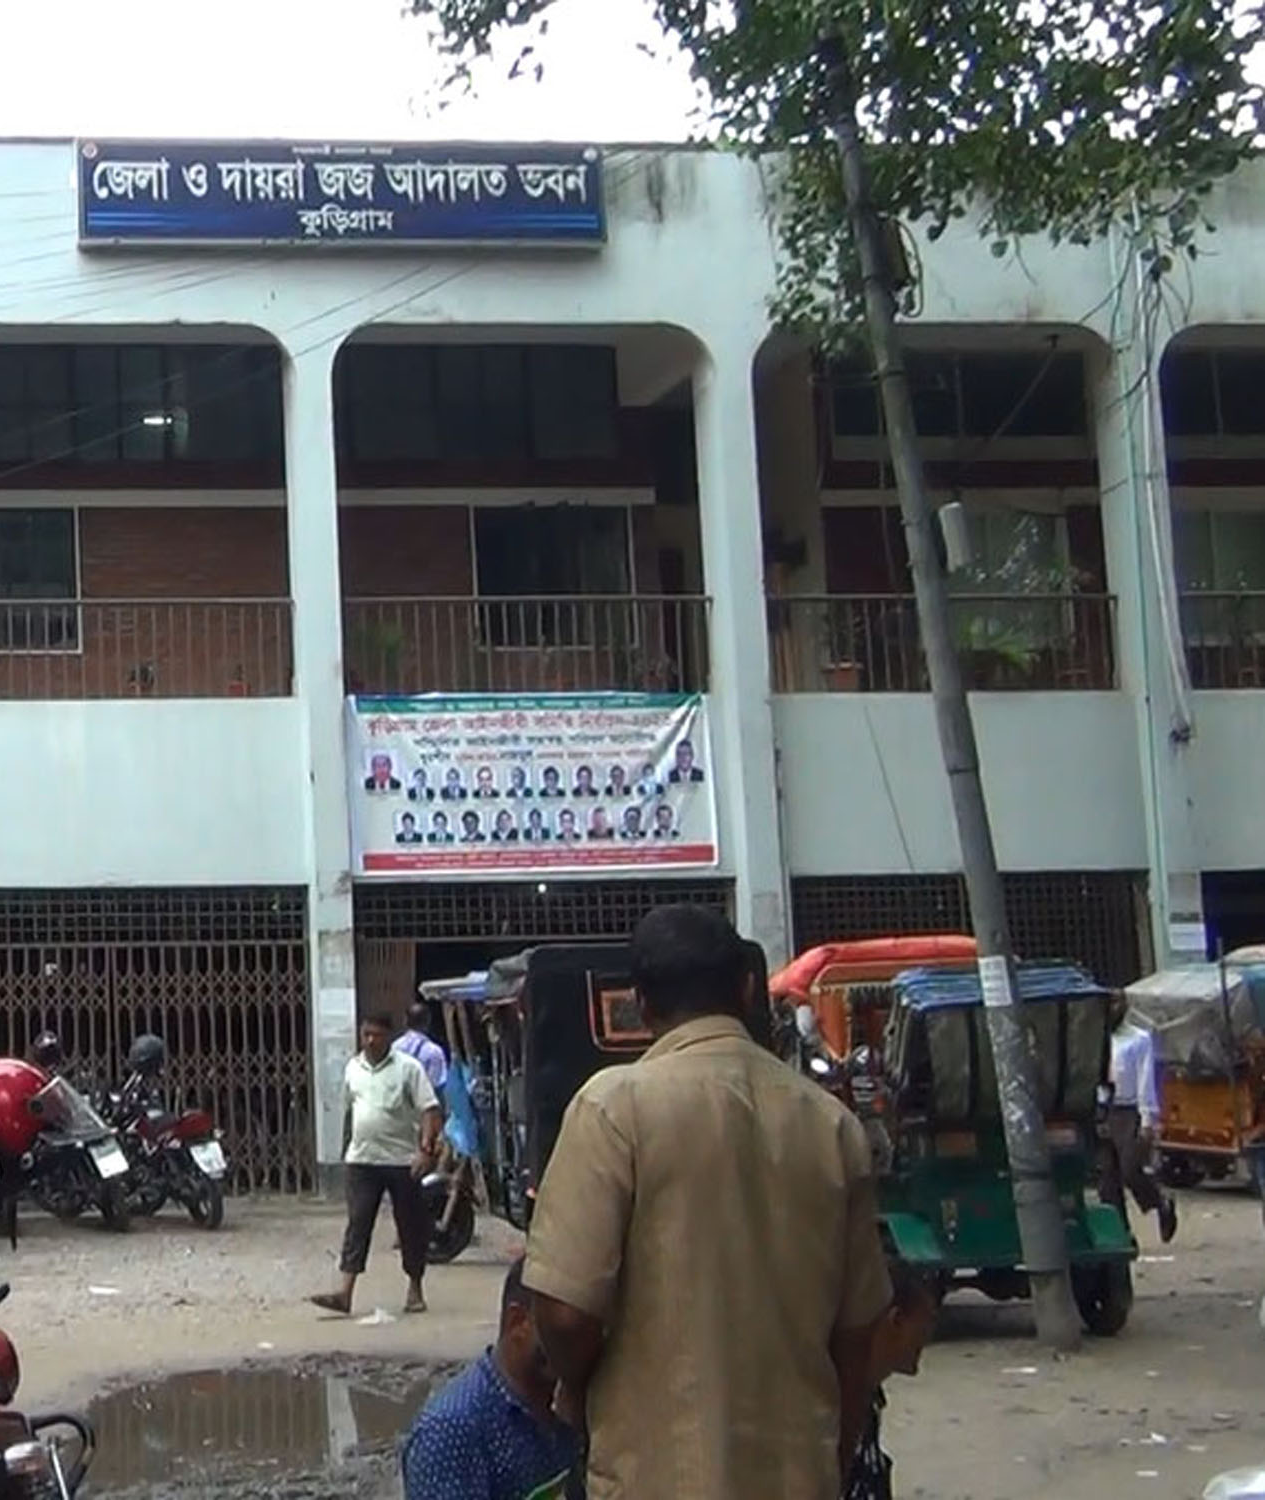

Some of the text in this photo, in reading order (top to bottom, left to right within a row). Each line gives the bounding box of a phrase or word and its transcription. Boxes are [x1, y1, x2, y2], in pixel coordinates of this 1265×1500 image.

[93, 157, 587, 203] জেলা ও দায়রা জজ আদালত ভবন
[297, 203, 394, 236] কুড়িগ্রাম
